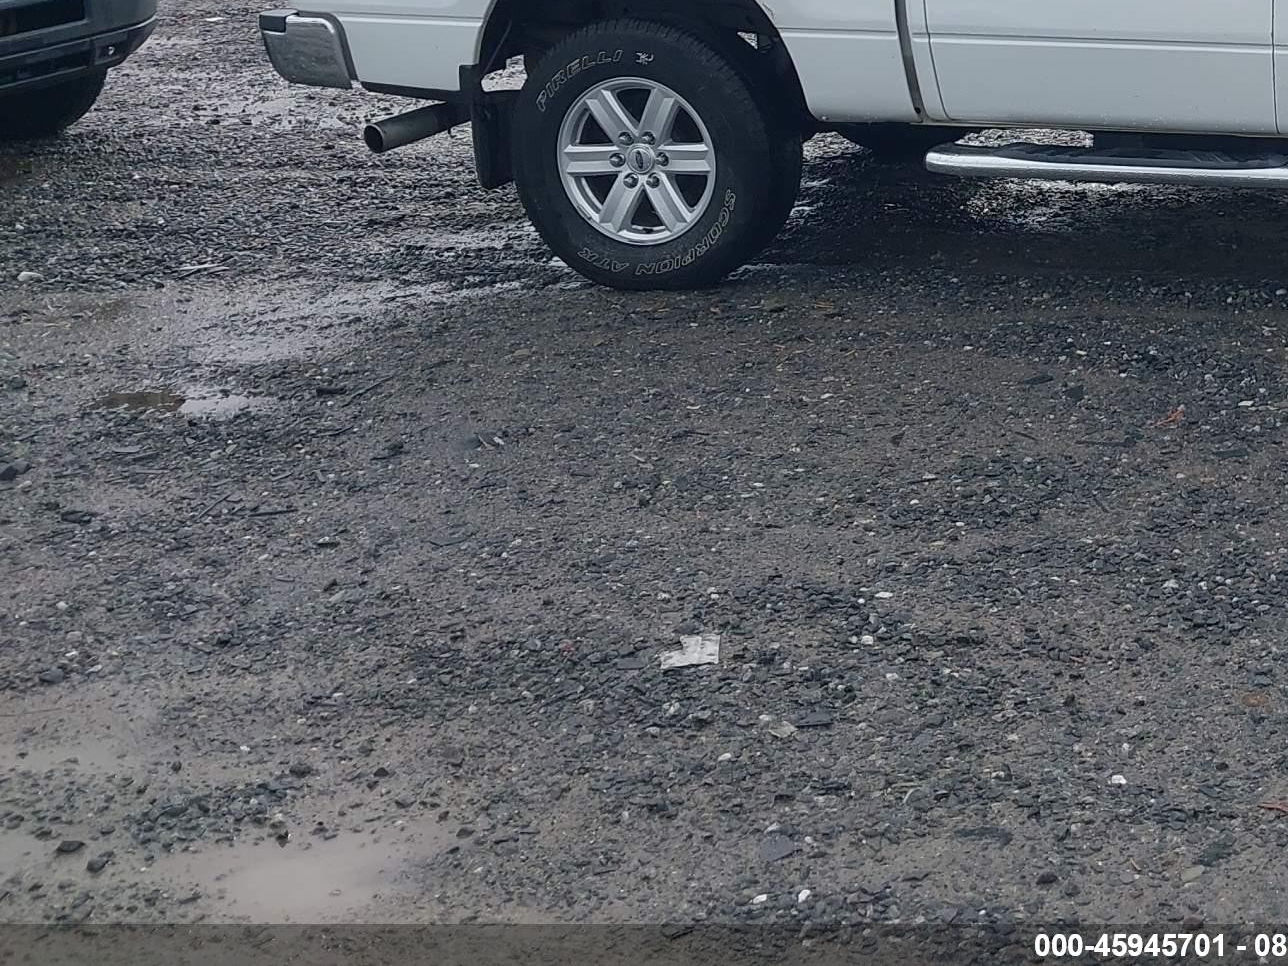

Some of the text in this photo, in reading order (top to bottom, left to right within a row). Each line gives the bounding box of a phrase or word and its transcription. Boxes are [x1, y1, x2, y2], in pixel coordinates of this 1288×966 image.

[535, 49, 624, 112] PIRELLI
[577, 188, 737, 276] SCORPION ATR
